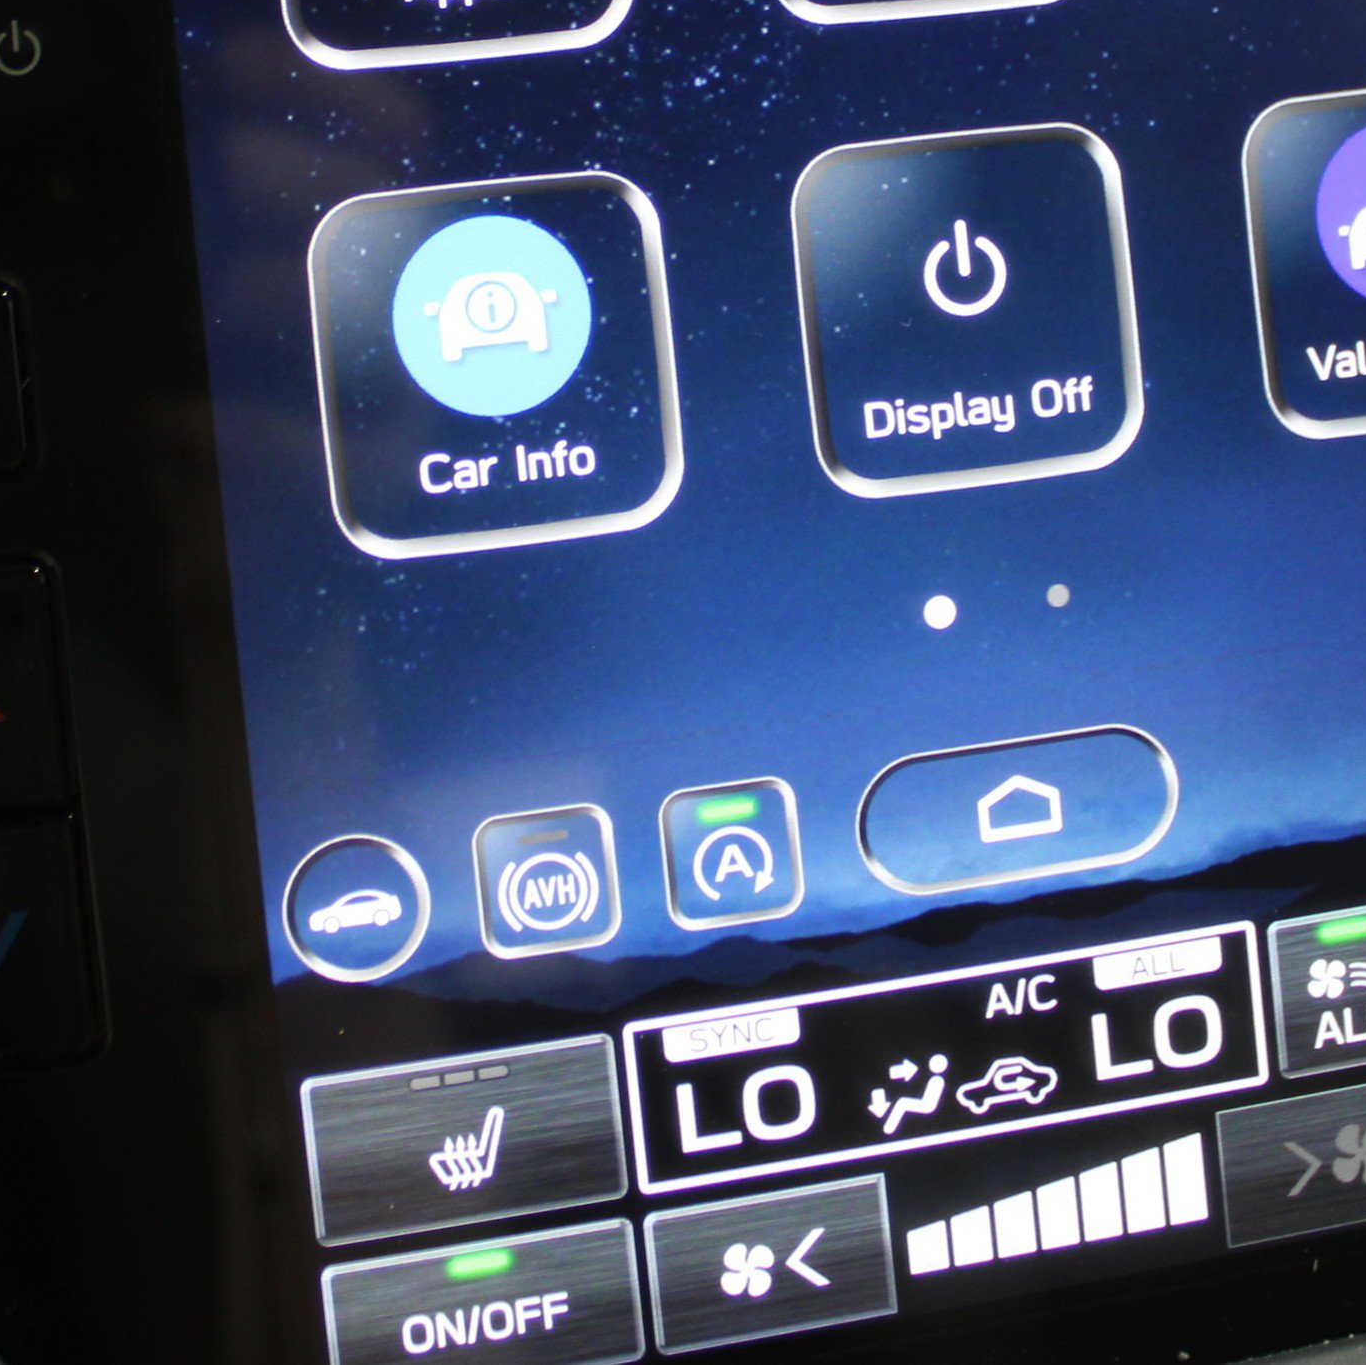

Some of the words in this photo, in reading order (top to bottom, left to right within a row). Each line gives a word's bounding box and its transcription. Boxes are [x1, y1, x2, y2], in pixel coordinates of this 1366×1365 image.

[864, 391, 1015, 441] Display
[1031, 375, 1093, 417] Off
[419, 453, 498, 493] Car
[516, 440, 596, 481] Info
[522, 872, 577, 912] AVH
[1131, 946, 1186, 980] ALL
[985, 973, 1058, 1020] A/C
[689, 1017, 774, 1053] SYNC
[1092, 995, 1222, 1080] LO
[676, 1065, 815, 1152] LO
[402, 1292, 568, 1353] ON/OFF
